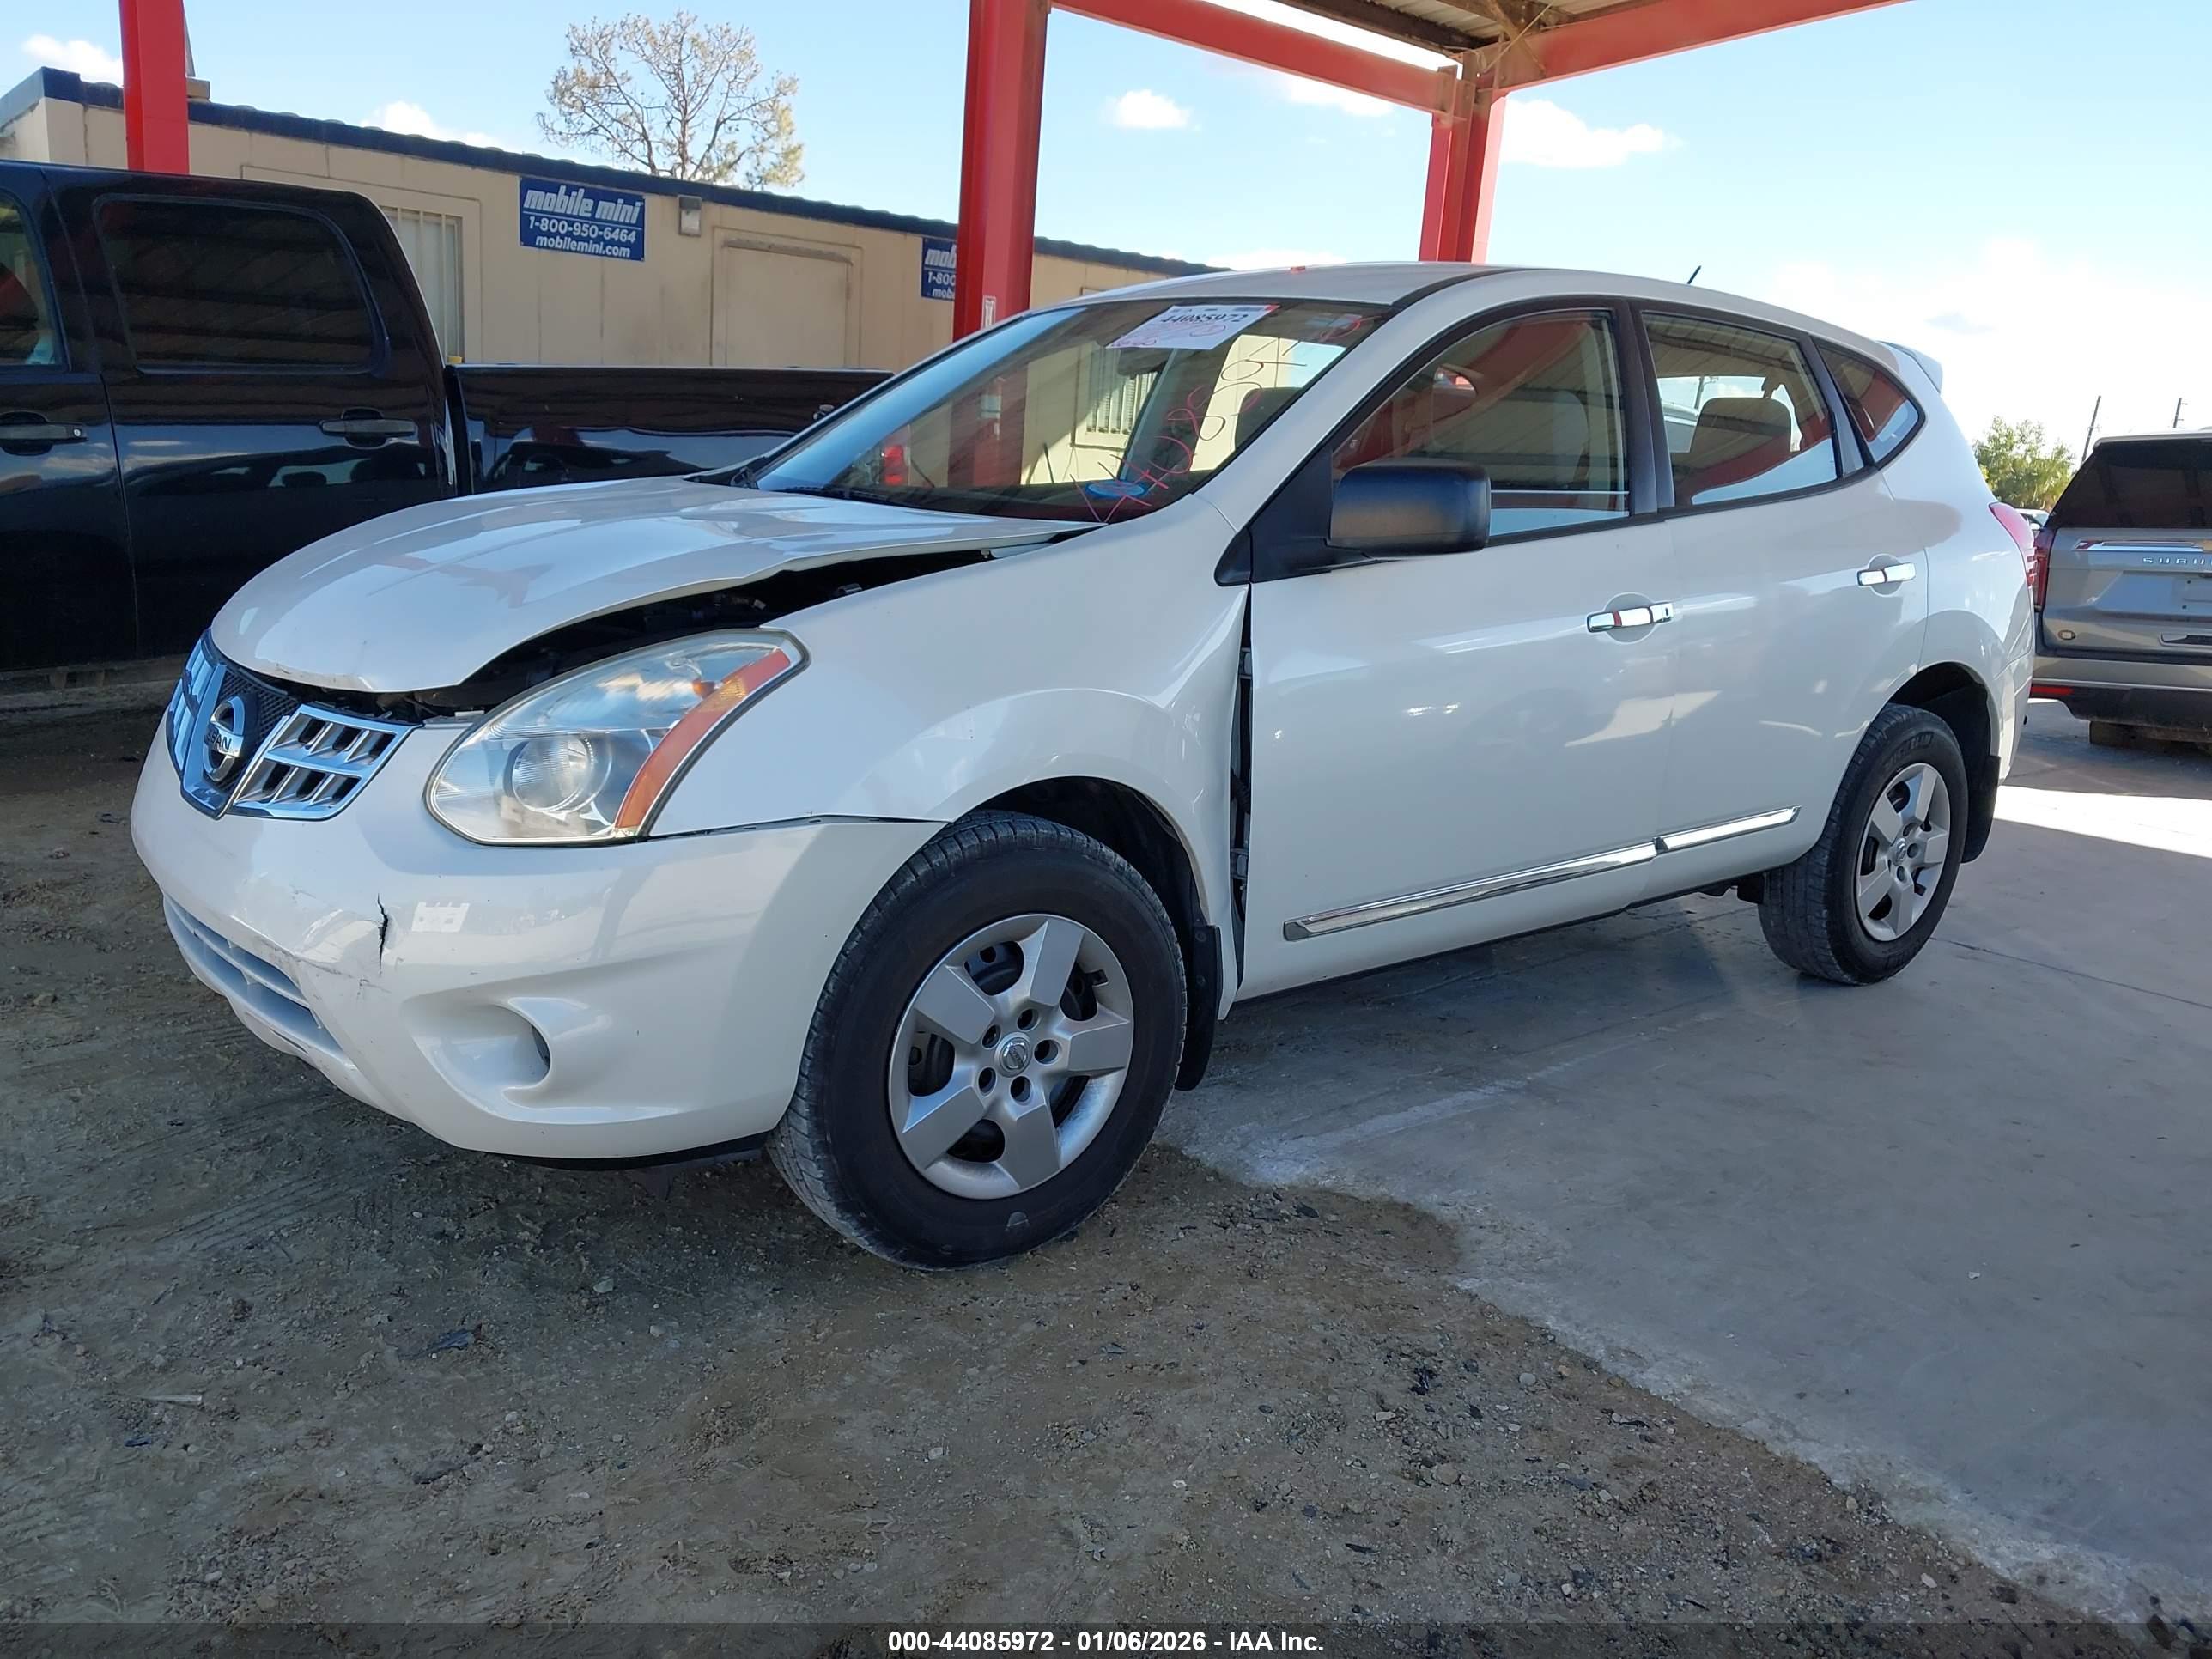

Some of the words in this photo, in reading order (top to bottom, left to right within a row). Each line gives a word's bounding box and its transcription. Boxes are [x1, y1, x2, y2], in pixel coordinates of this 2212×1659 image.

[523, 185, 594, 217] mobile
[595, 198, 641, 224] mini
[529, 216, 636, 244] 1-800-950-6464
[536, 235, 630, 258] mobilemini.com
